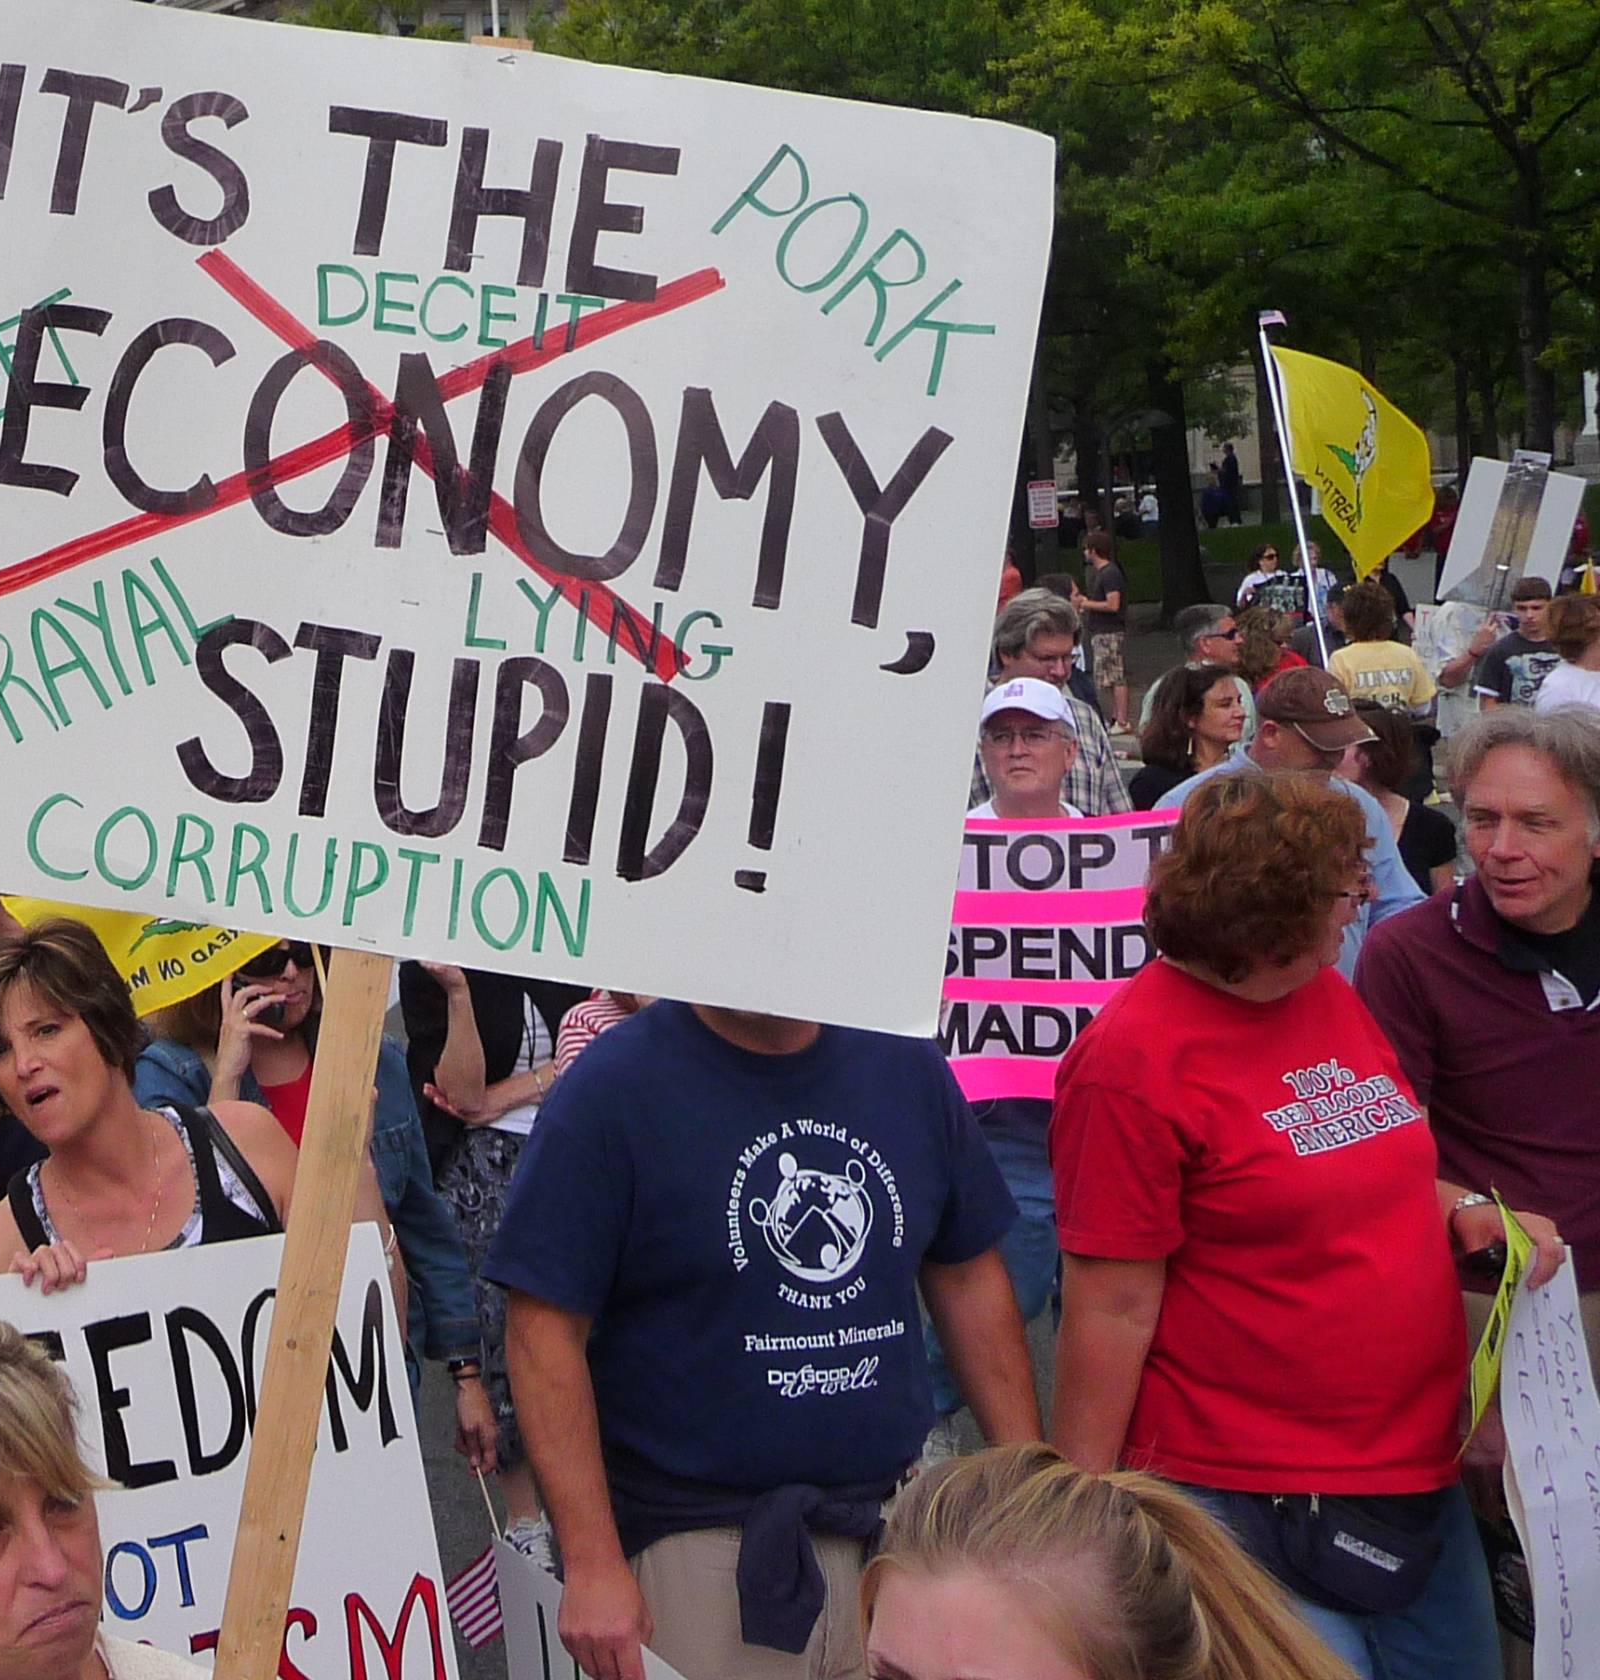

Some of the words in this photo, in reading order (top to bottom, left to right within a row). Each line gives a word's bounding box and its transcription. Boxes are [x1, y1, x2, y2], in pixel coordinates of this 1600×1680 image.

[328, 104, 681, 302] THE
[316, 263, 605, 353] DECEIT
[710, 142, 996, 396] PORK
[465, 572, 734, 682] LYING
[175, 617, 792, 893] STUPID!
[26, 792, 592, 958] CORRUPTION
[959, 832, 1117, 891] TOP
[1263, 1101, 1313, 1132] RED
[1309, 1075, 1398, 1119] BLOODED
[1282, 1058, 1355, 1098] 100%
[1288, 1095, 1423, 1156] AMERICAN
[726, 1168, 750, 1272] Volunteers
[738, 1131, 778, 1169] Make
[781, 1121, 795, 1140] A
[796, 1118, 848, 1143] World
[850, 1137, 870, 1156] of
[866, 1149, 905, 1249] Difference
[744, 1330, 836, 1352] Fairmount
[837, 1318, 905, 1347] Minerals
[777, 1282, 833, 1310] THANK
[836, 1275, 867, 1305] YOU
[99, 1523, 209, 1622] OT
